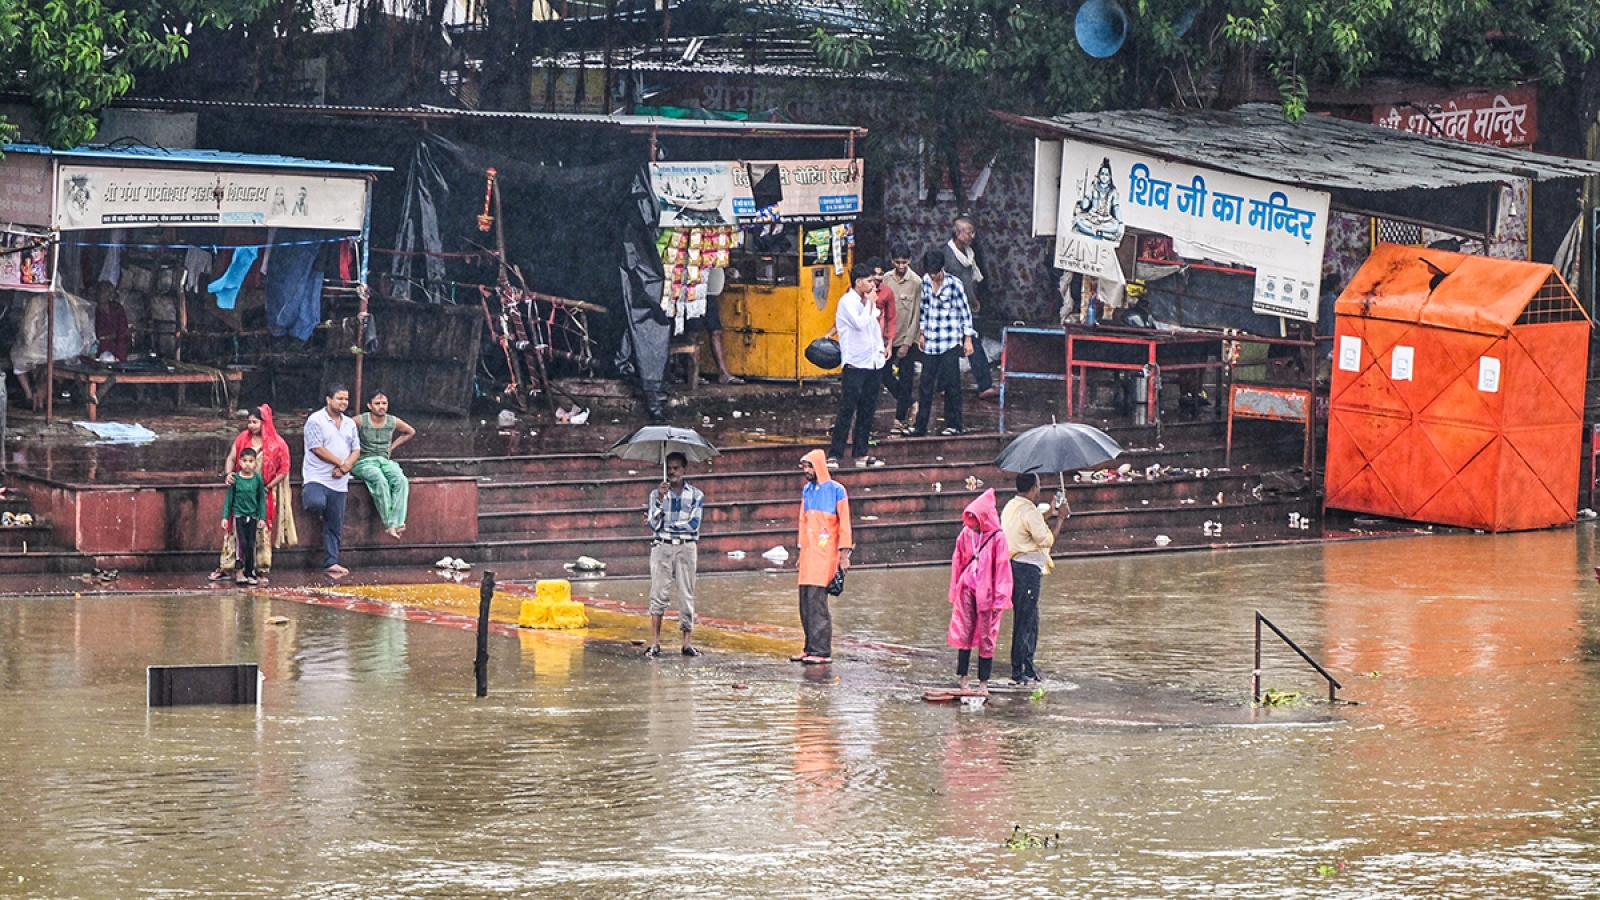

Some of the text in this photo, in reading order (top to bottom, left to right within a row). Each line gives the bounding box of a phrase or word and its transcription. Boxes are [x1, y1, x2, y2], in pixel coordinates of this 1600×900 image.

[1474, 95, 1527, 142] मन्दिर
[104, 183, 118, 202] श्री
[1129, 163, 1316, 240] शिव जी का मन्दिर
